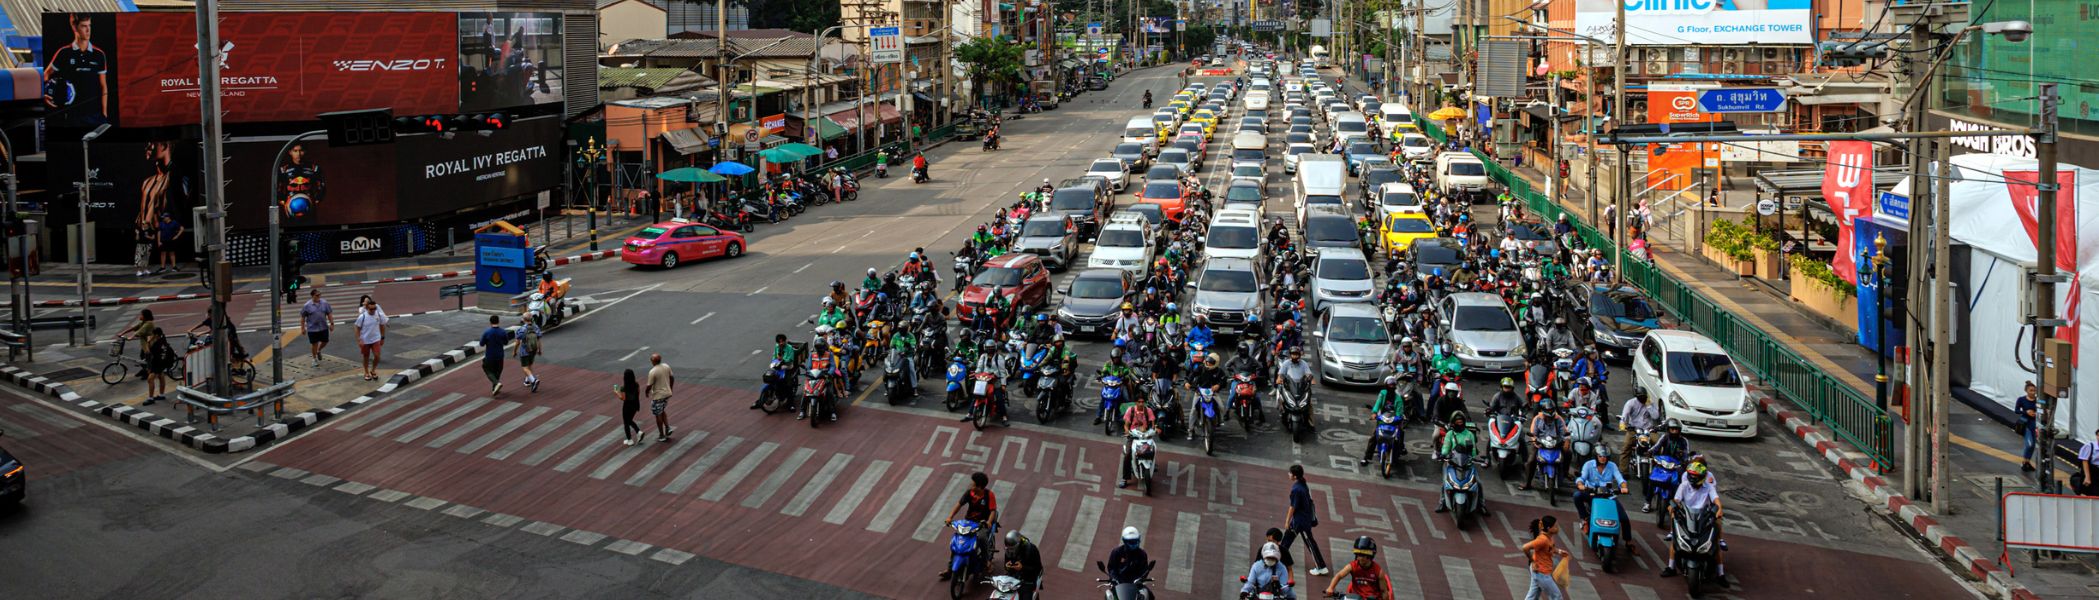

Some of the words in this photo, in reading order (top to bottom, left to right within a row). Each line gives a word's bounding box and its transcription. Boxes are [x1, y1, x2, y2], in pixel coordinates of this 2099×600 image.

[1687, 25, 1711, 33] Floor,
[1714, 25, 1765, 33] EXCHANGE
[1768, 24, 1802, 32] TOWER
[350, 60, 430, 71] ENZO
[434, 58, 445, 69] T.
[161, 79, 194, 87] ROYAL
[221, 76, 278, 85] REGATTA
[1730, 90, 1767, 104] สุขุมวิท
[1950, 119, 1989, 152] DOUGH
[1992, 127, 2037, 159] BROS
[425, 159, 470, 179] ROYAL
[473, 155, 492, 170] IVY
[496, 145, 547, 166] REGATTA
[341, 237, 381, 251] BMN
